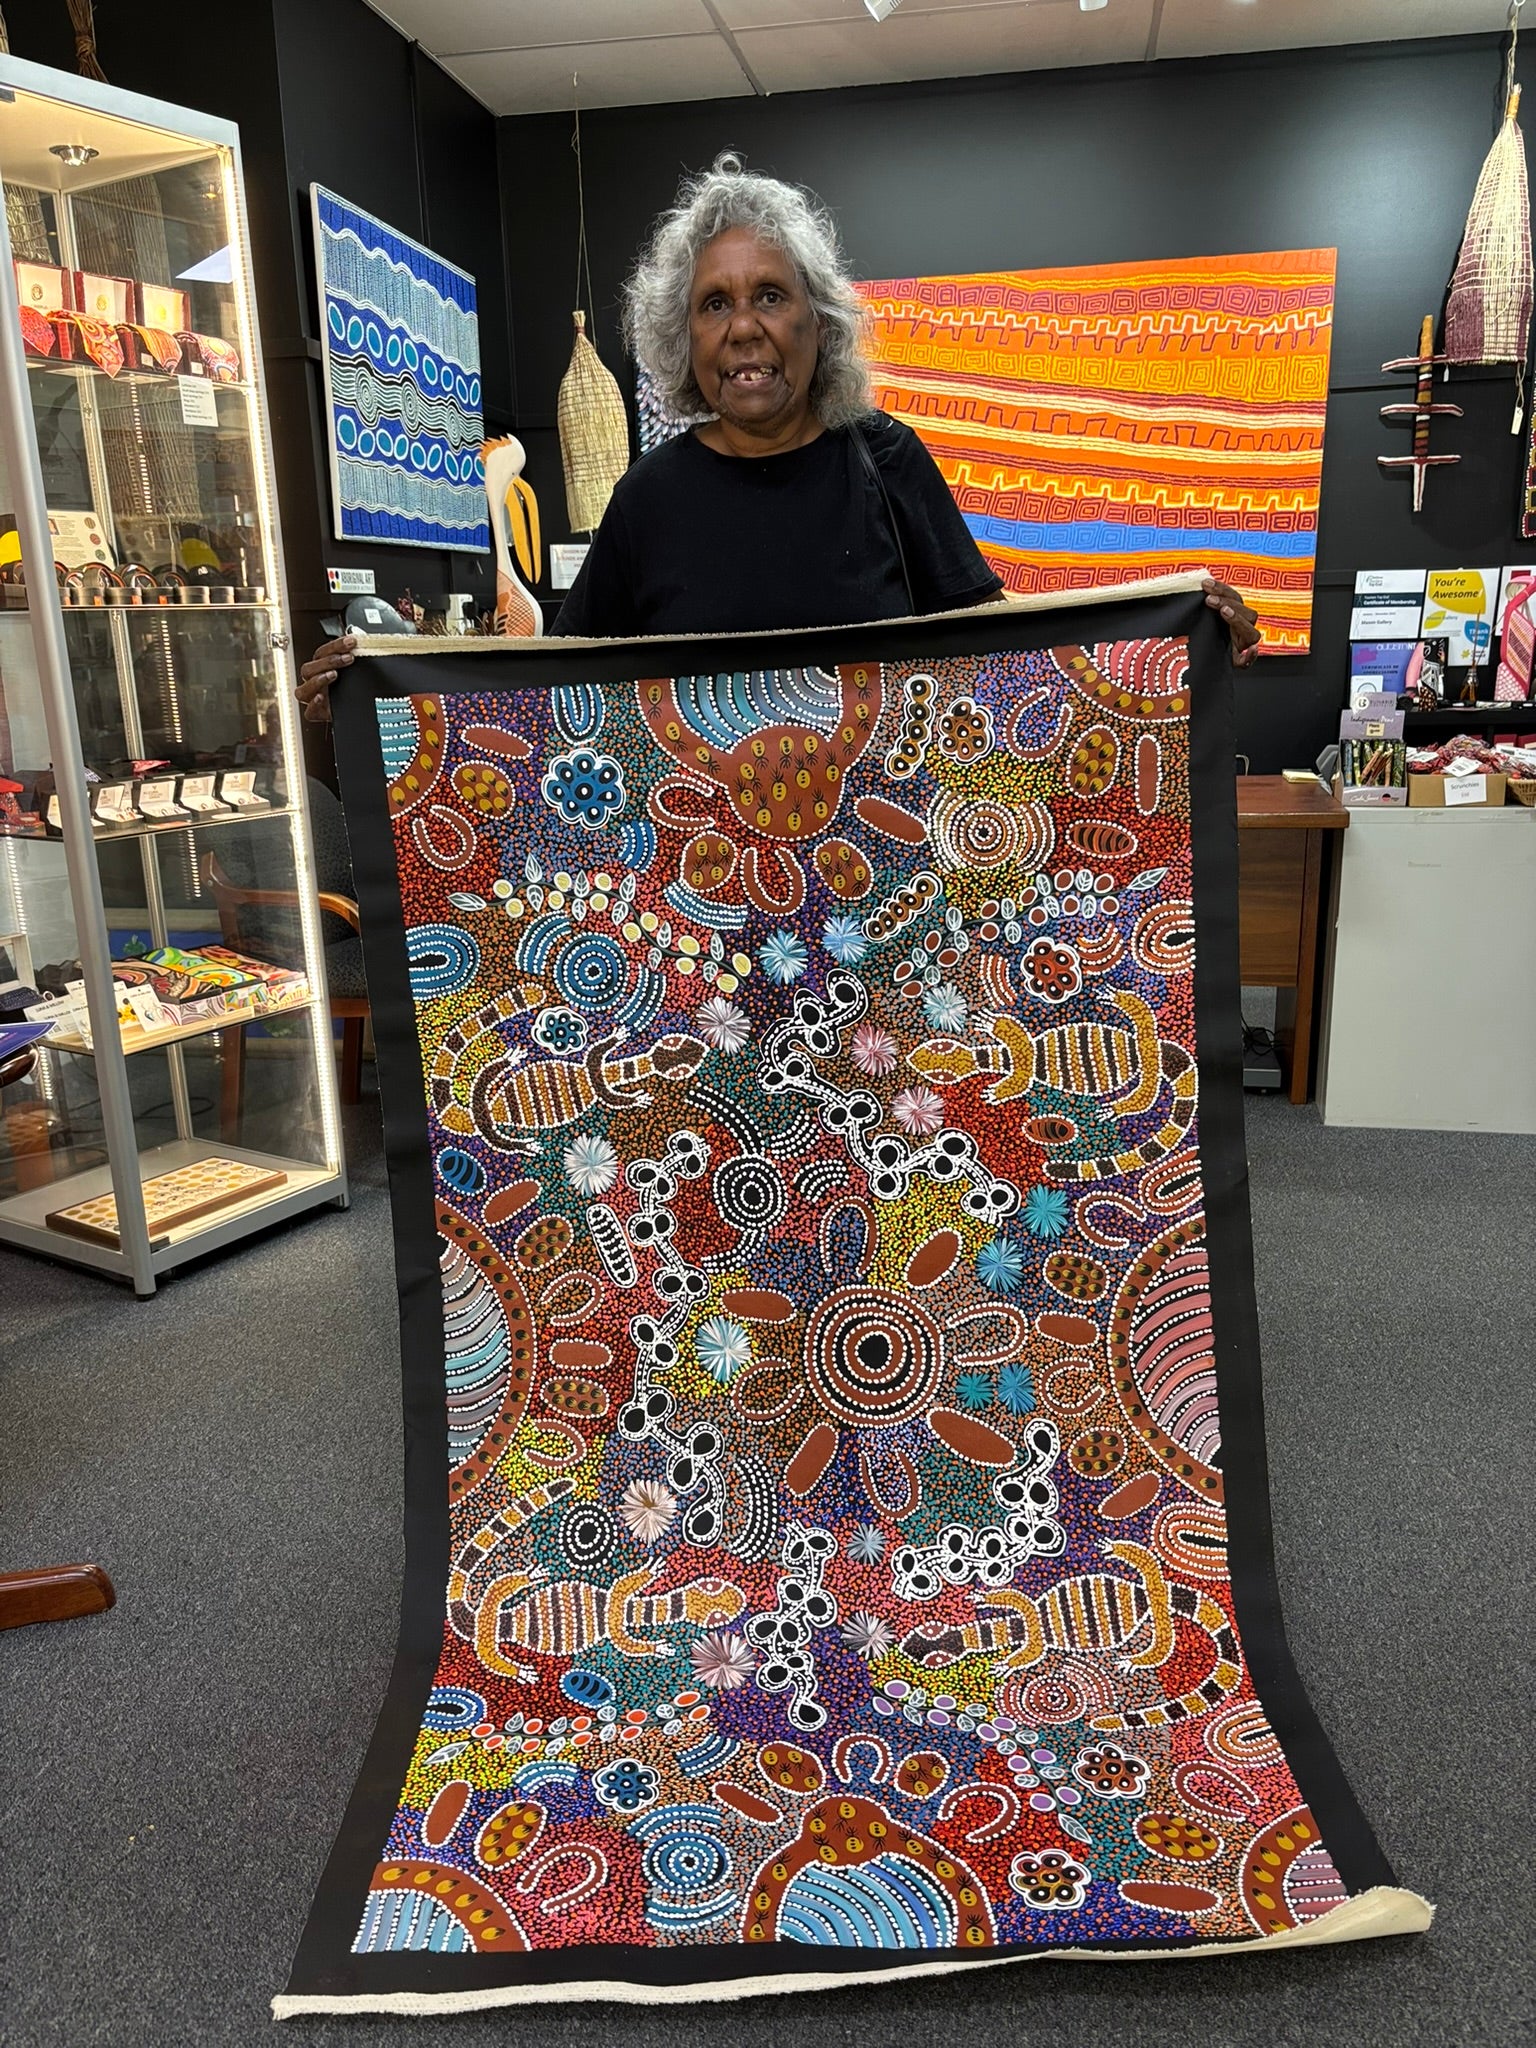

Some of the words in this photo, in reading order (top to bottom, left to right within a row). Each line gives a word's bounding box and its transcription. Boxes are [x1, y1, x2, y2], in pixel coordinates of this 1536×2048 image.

[1435, 577, 1466, 586] You're
[1432, 590, 1479, 599] Awesome
[1450, 782, 1479, 790] Scrunchies
